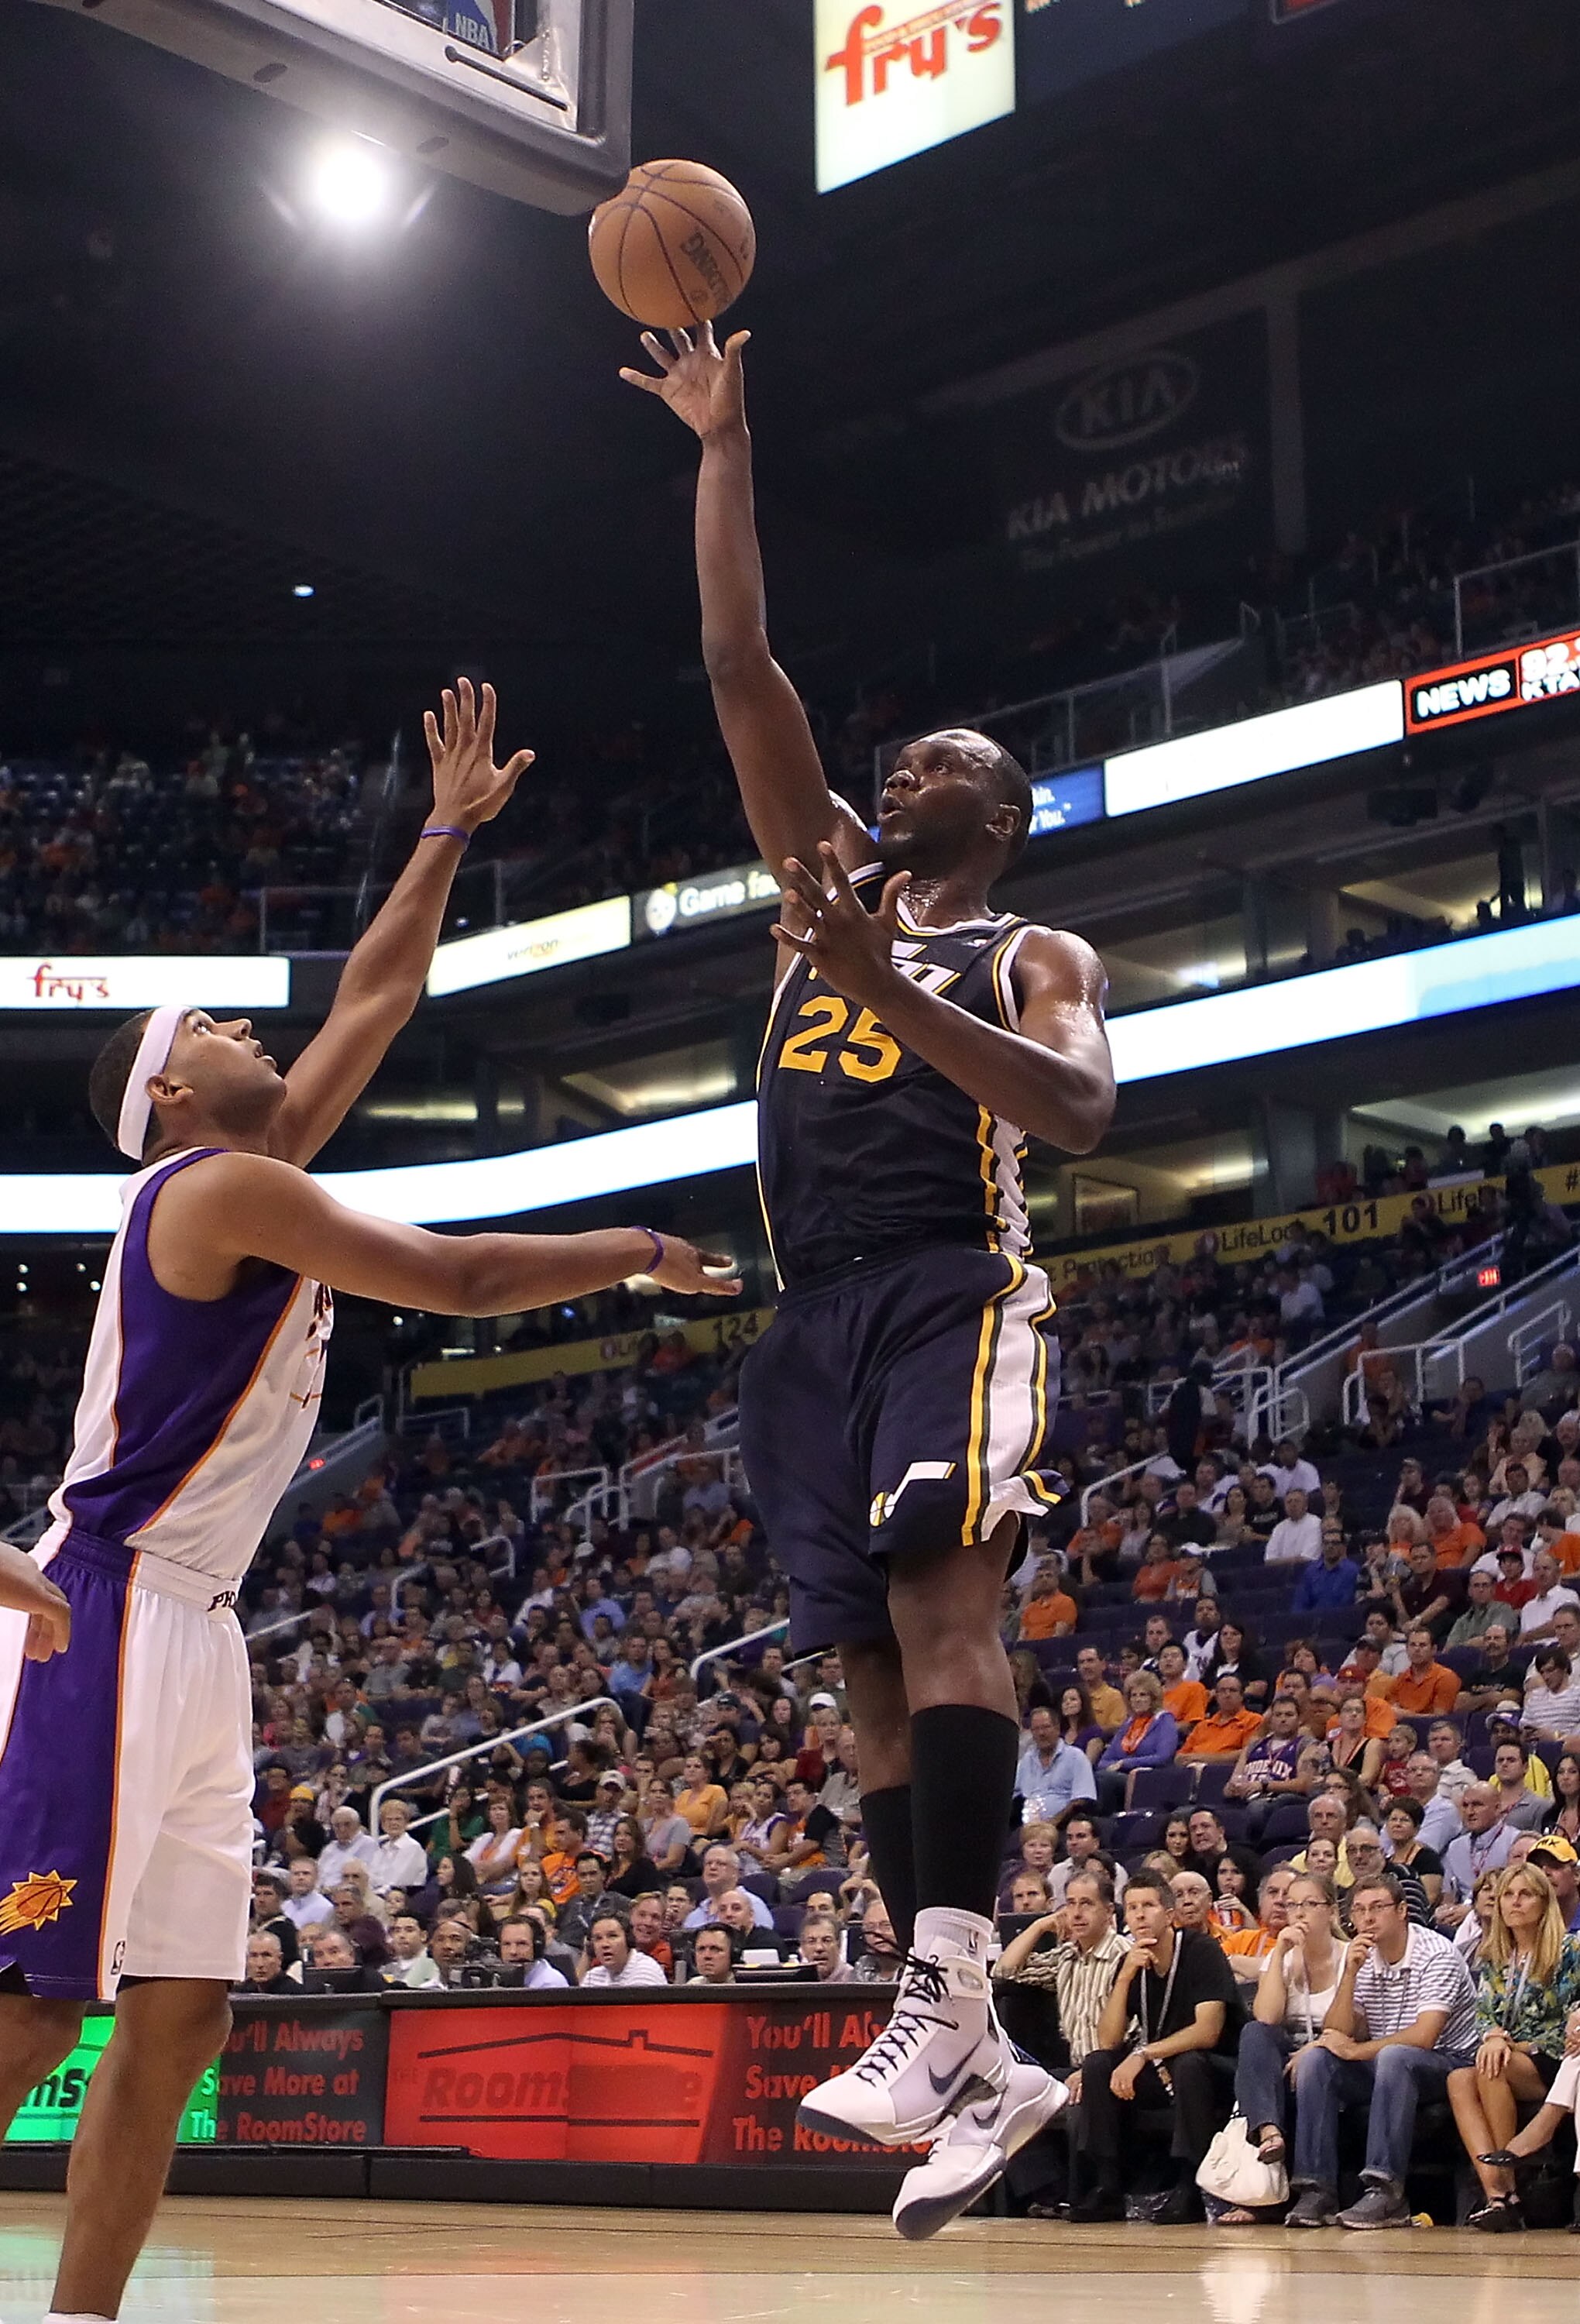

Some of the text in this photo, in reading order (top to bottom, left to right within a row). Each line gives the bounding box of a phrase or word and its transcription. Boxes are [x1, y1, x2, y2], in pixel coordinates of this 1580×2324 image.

[455, 12, 489, 50] NBA
[824, 4, 1001, 106] fry's
[1081, 367, 1176, 434] KIA
[1007, 491, 1070, 541] KIA
[1417, 669, 1511, 718] NEWS
[1521, 670, 1580, 702] KTA
[678, 881, 747, 916] Game
[33, 964, 109, 1000] fry's
[778, 995, 902, 1082] 25
[1322, 1202, 1378, 1236] 101
[713, 1312, 760, 1346] 124
[273, 2020, 364, 2061] Always
[747, 2012, 831, 2050] You'll
[263, 2066, 326, 2096] More
[333, 2069, 360, 2096] at
[746, 2064, 818, 2099] Save
[191, 2109, 368, 2144] The RoomStore
[733, 2115, 783, 2152] The
